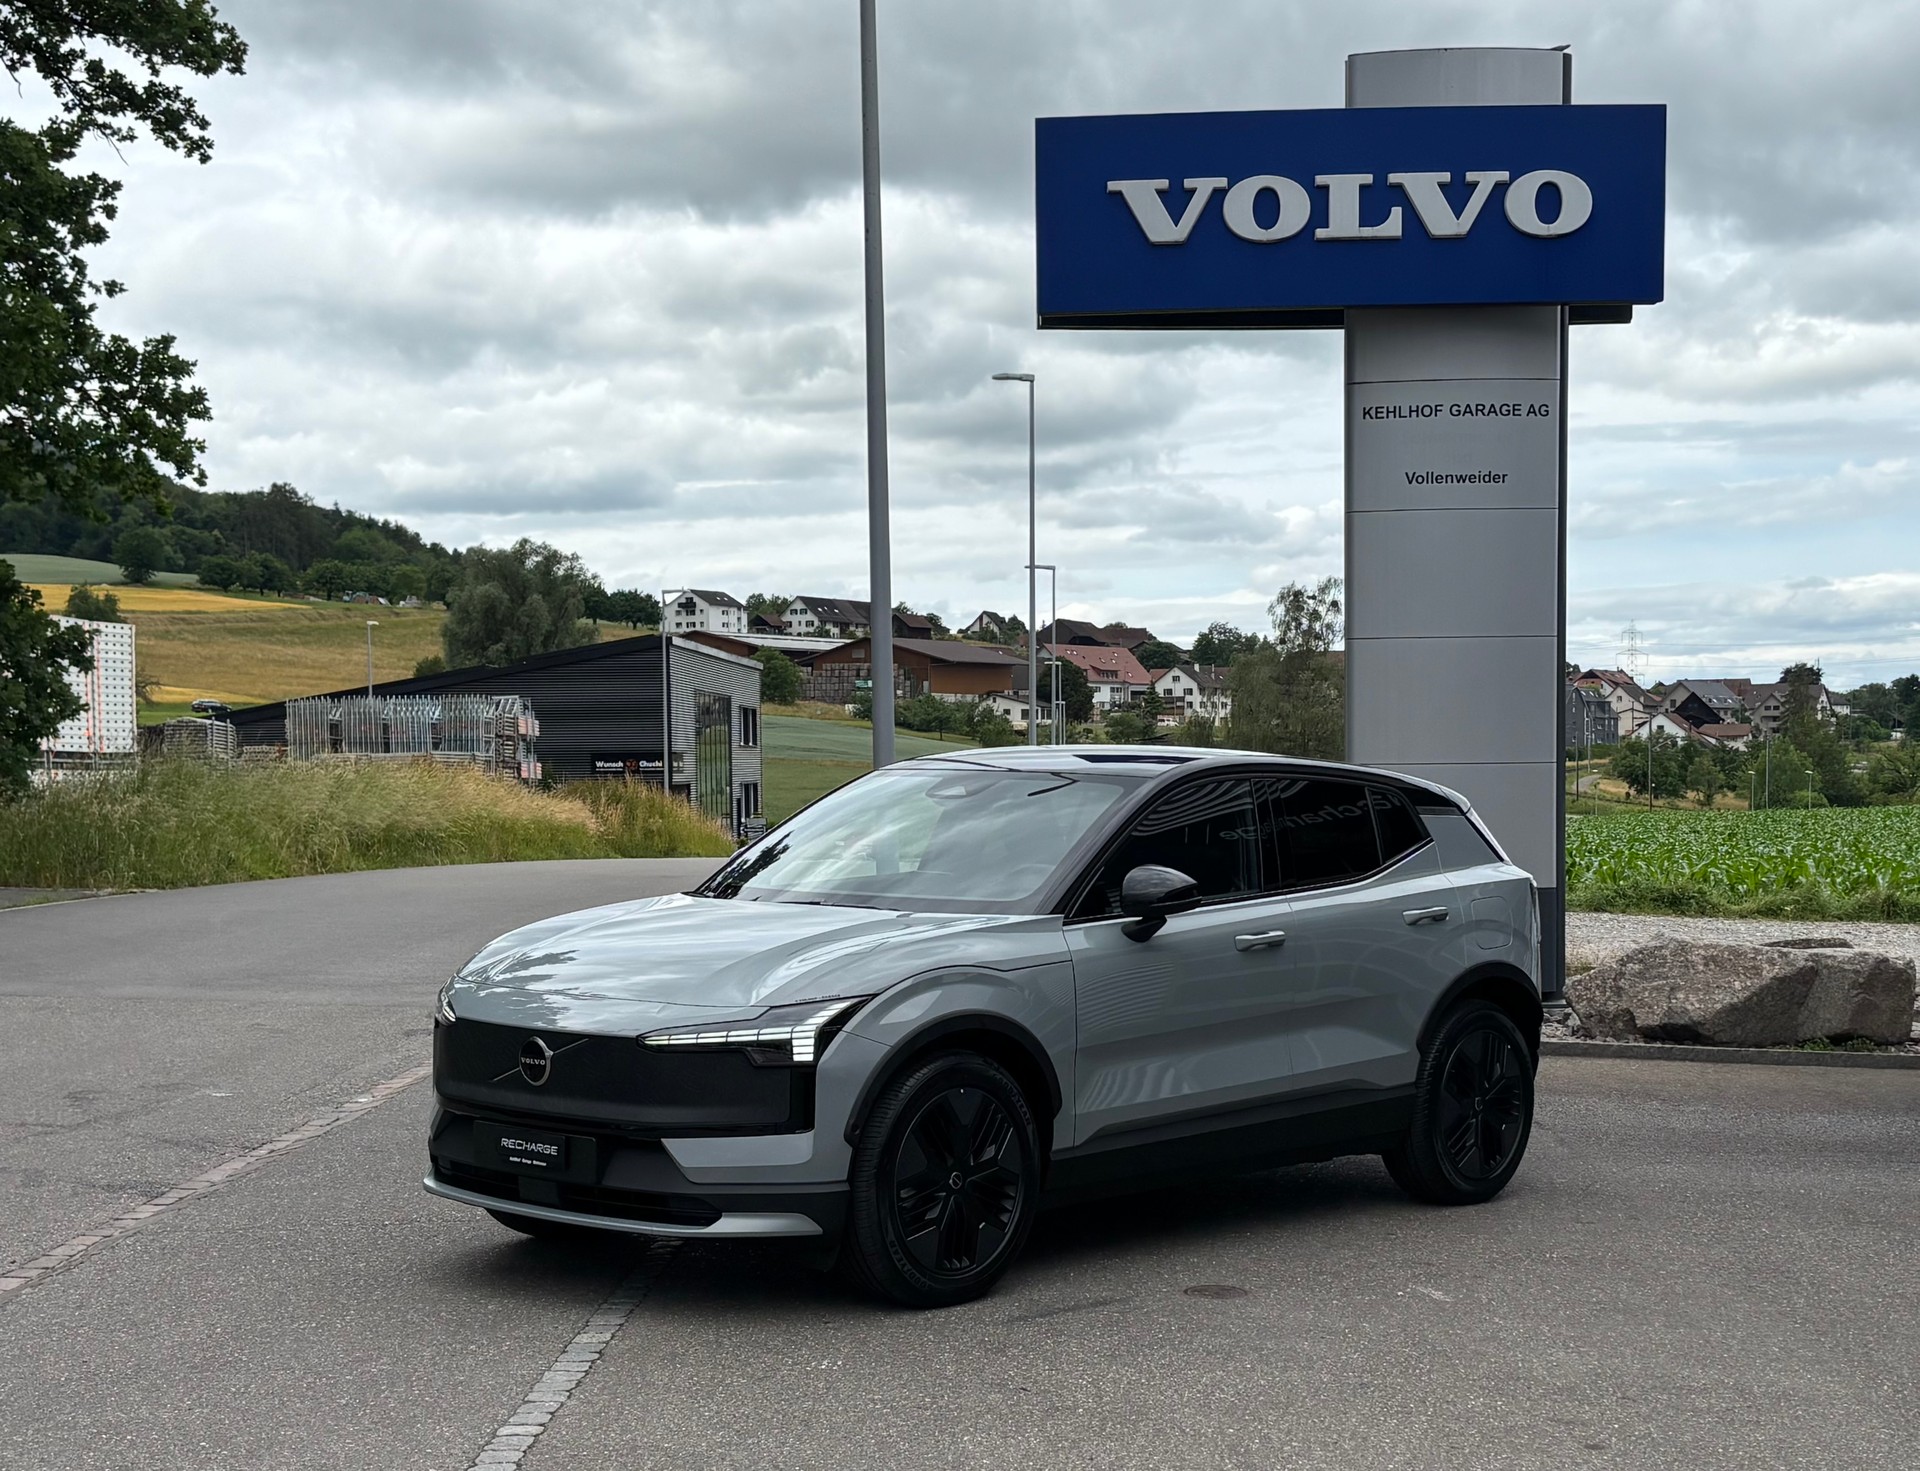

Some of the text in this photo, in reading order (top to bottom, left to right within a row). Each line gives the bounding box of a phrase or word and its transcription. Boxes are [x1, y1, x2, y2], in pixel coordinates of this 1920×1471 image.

[1106, 169, 1594, 246] VOLVO
[1362, 403, 1550, 420] KEHLHOF GARAGE AG
[1405, 470, 1508, 485] Vollenweider
[595, 760, 624, 768] Wunsch
[520, 1056, 546, 1066] VOLVO
[501, 1138, 559, 1156] RECHARGE
